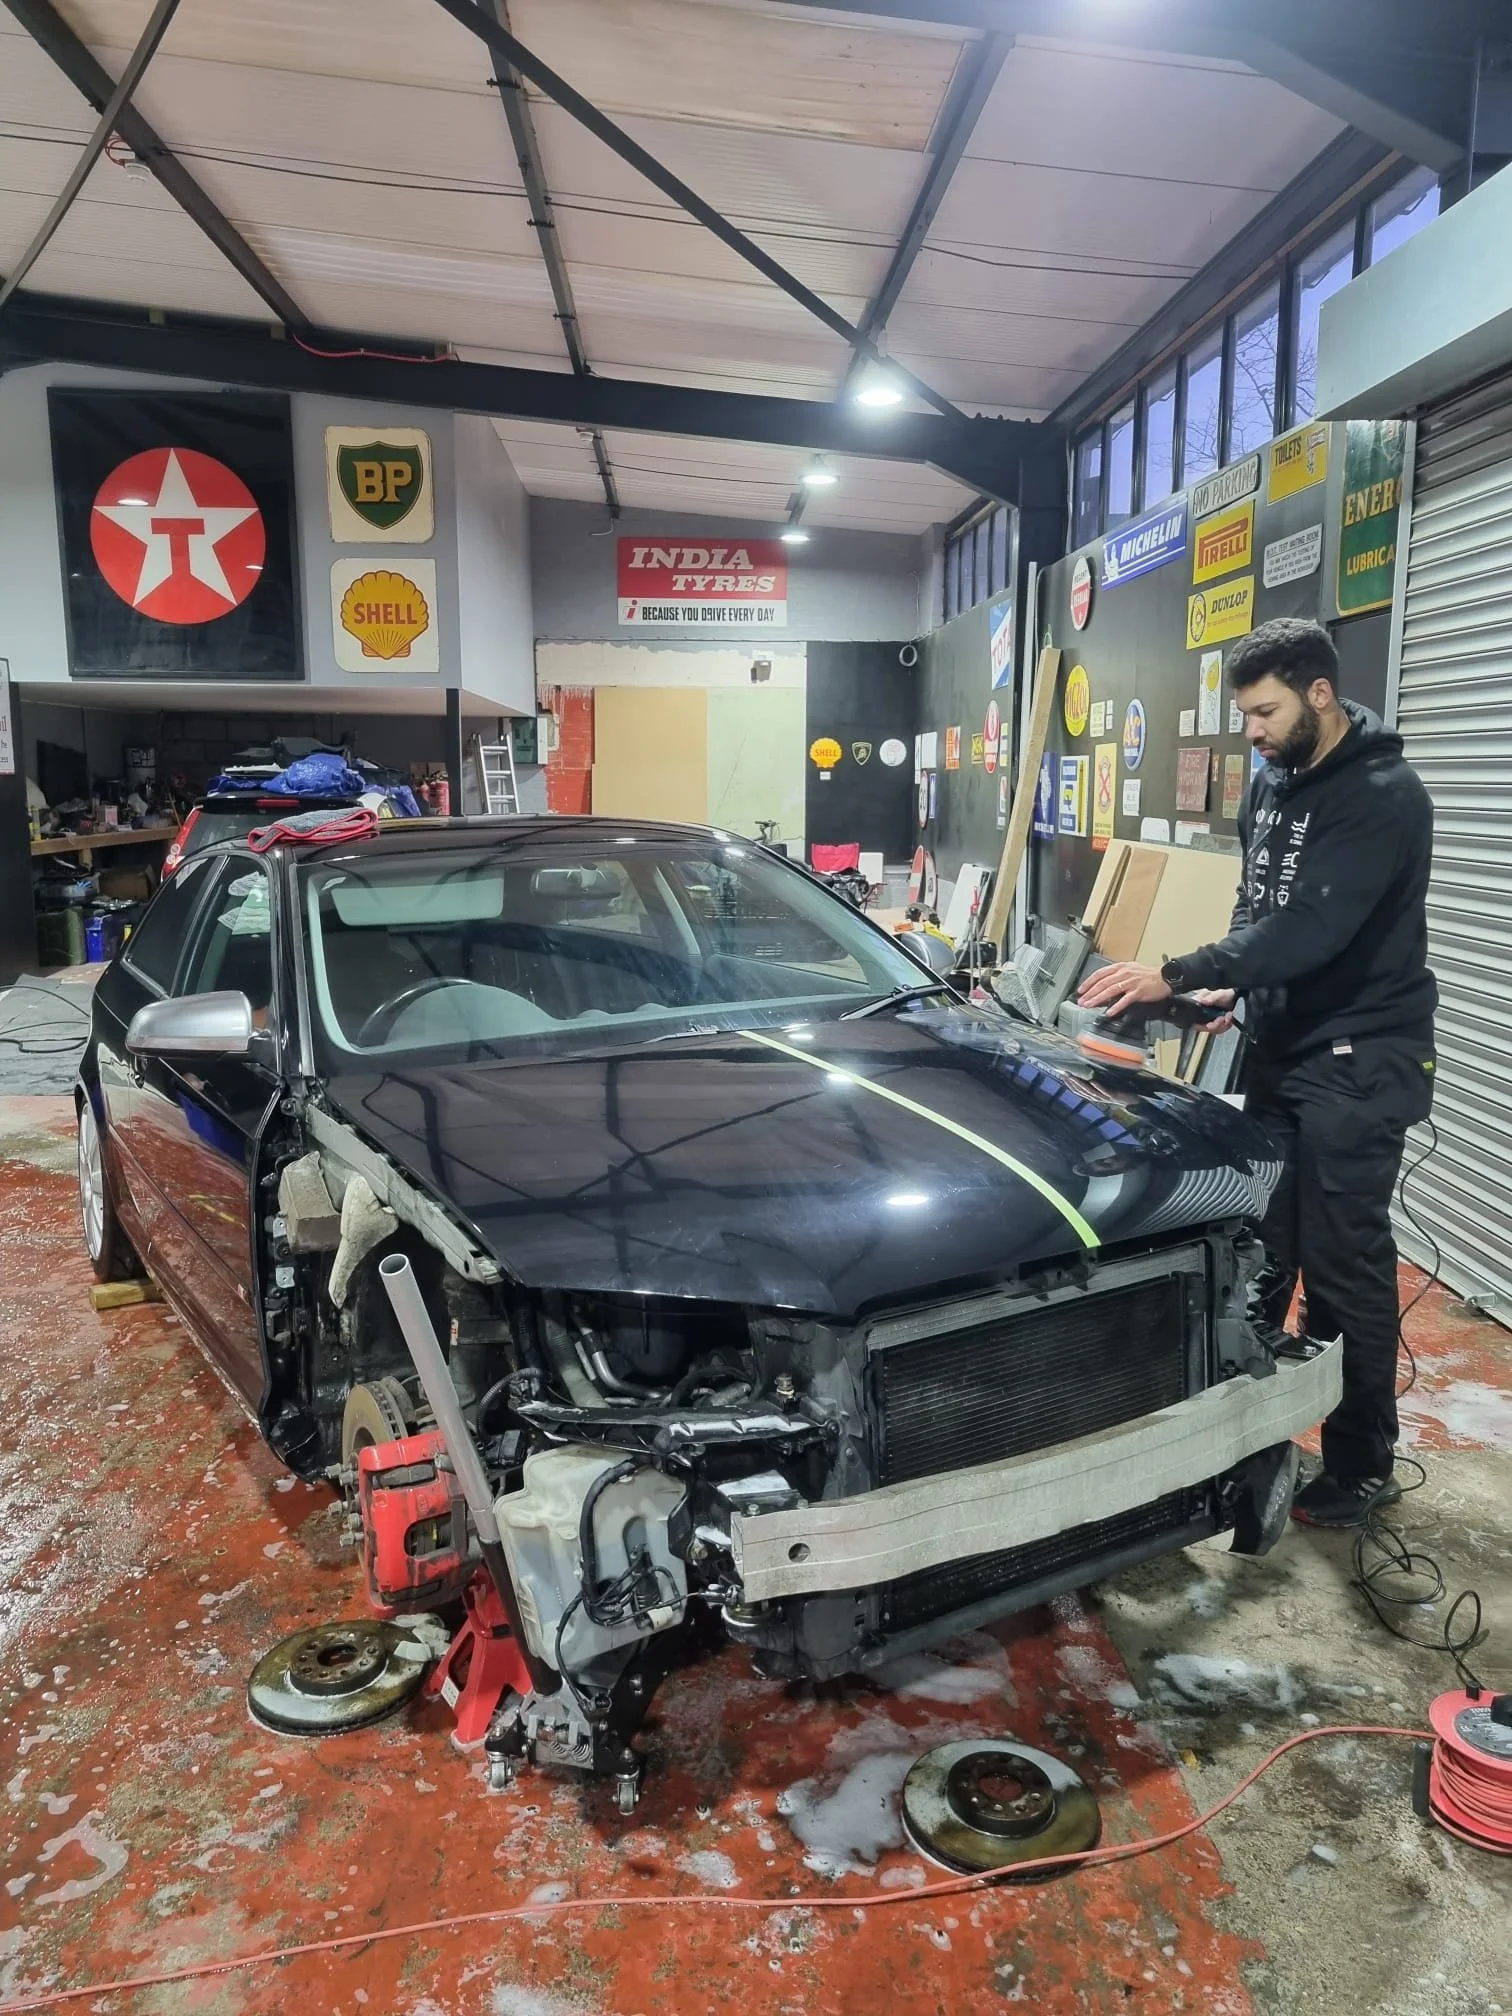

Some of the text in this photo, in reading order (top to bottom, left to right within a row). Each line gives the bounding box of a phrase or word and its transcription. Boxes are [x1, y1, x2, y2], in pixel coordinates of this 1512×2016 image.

[352, 461, 413, 503] BP
[1195, 487, 1209, 517] NO
[1212, 463, 1257, 506] PARKING
[1120, 514, 1182, 564] MICHELIN
[1197, 517, 1249, 569] PIRELLI
[628, 547, 754, 570] INDIA
[672, 574, 776, 593] TYRES
[353, 602, 417, 625] SHELL
[1211, 590, 1248, 614] DUNLOP
[642, 607, 680, 621] BECAUSE
[682, 607, 699, 621] YOU
[701, 607, 726, 622] DRIVE
[728, 607, 754, 622] EVERY
[757, 608, 775, 622] DAY
[815, 748, 837, 758] SHELL
